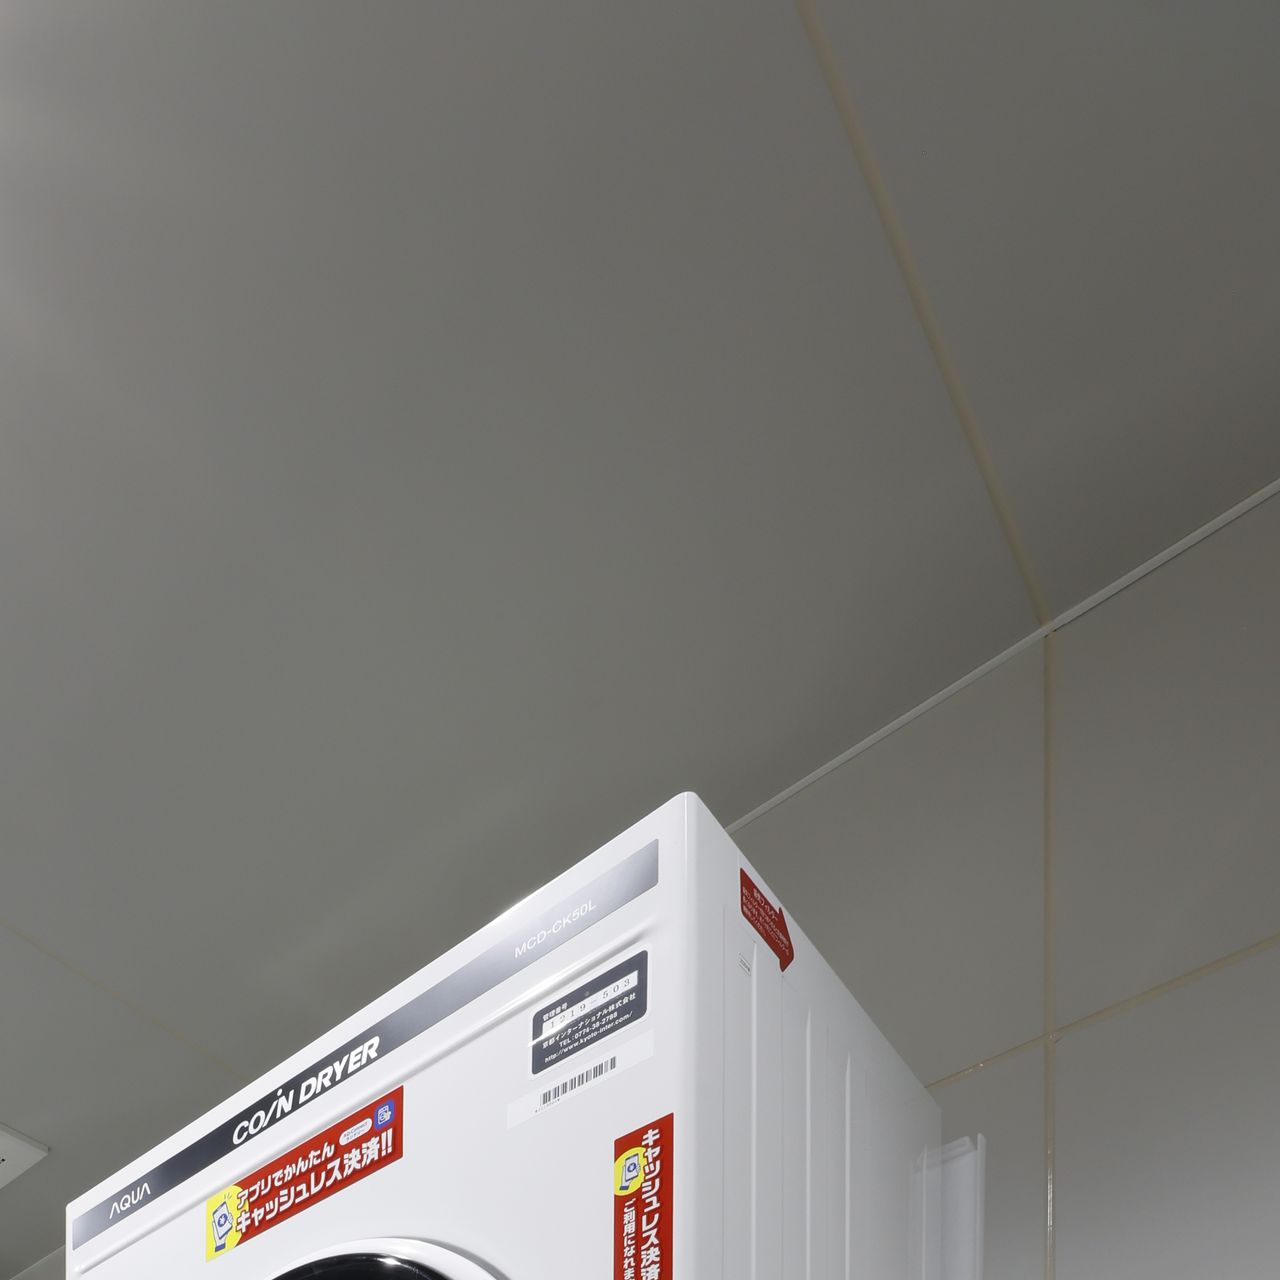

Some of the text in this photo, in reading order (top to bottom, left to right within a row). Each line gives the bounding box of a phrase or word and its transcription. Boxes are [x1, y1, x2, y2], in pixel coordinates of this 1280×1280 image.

[514, 899, 597, 959] MCD-CK50L
[542, 1002, 568, 1022] 管理番号
[232, 1035, 380, 1145] COIN DRYER
[109, 1182, 151, 1219] AQUA
[236, 1142, 335, 1209] アプリでかんたん
